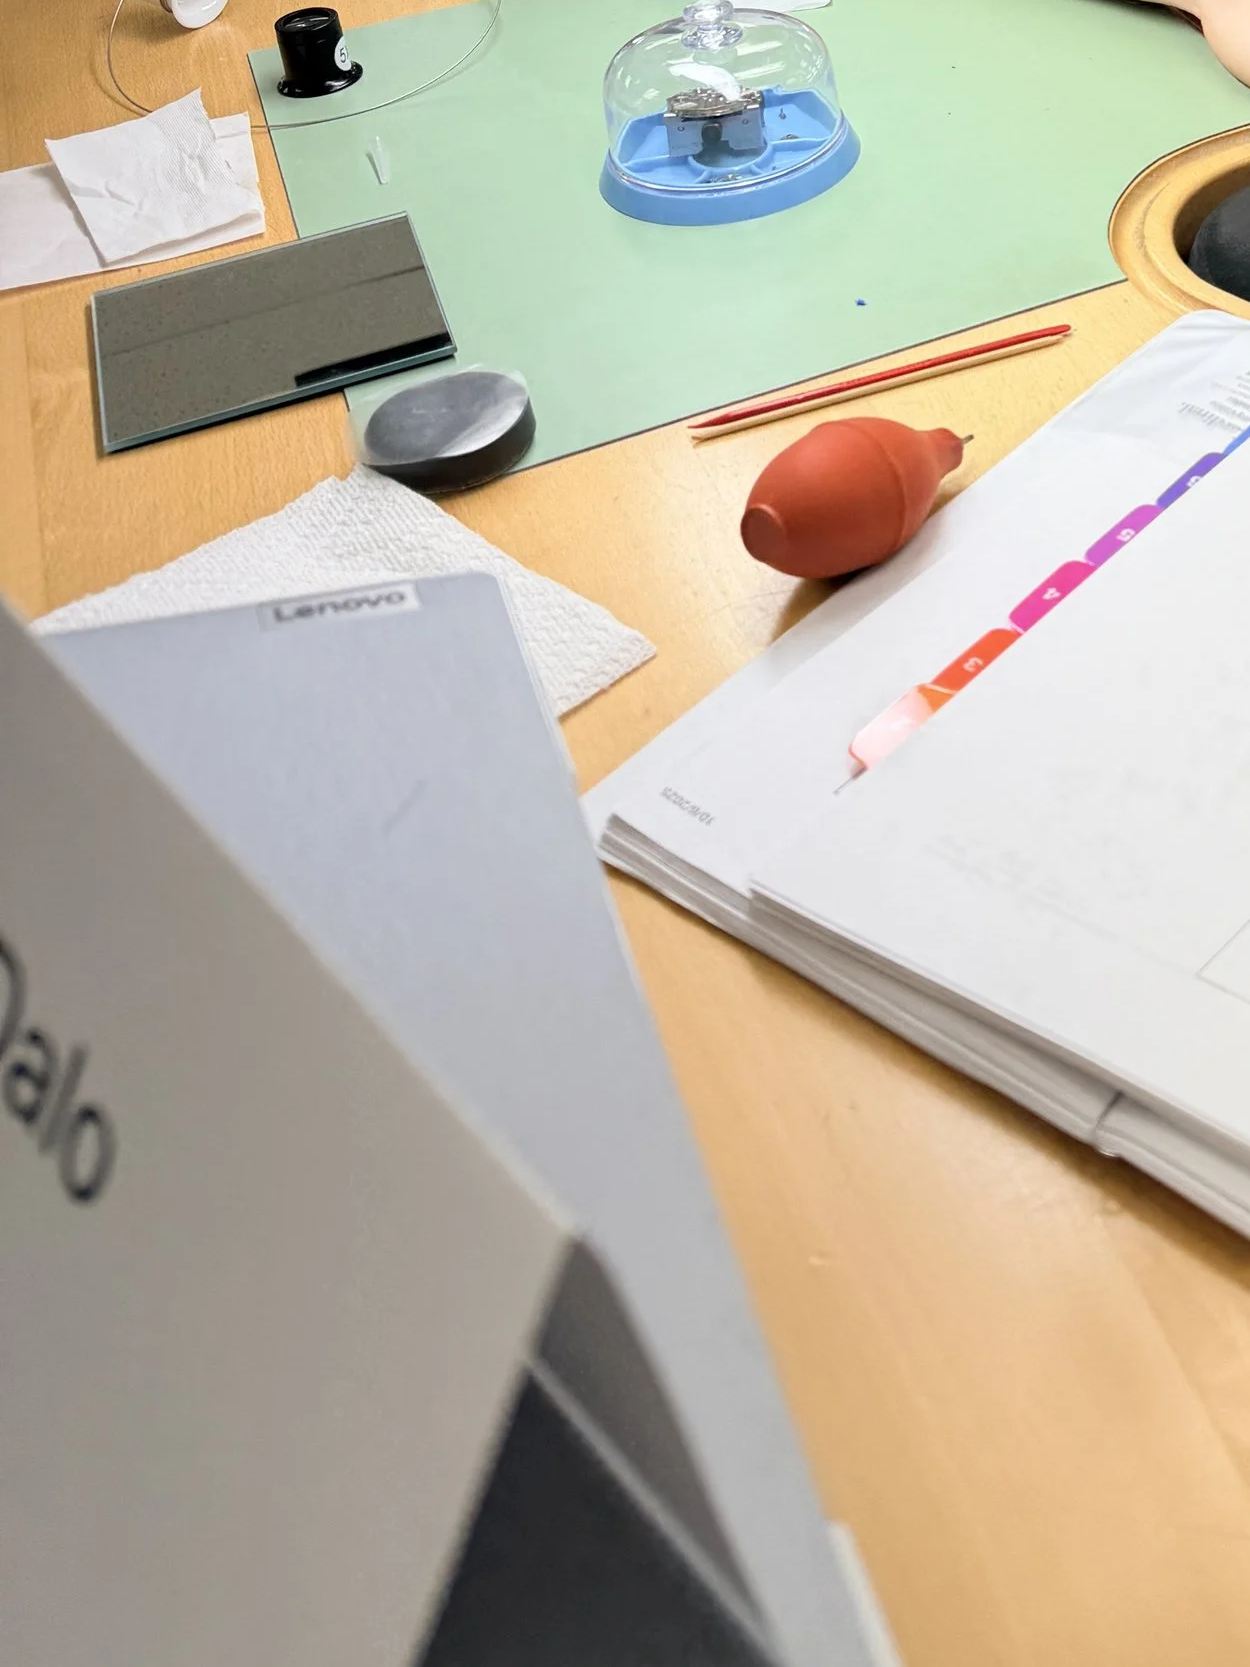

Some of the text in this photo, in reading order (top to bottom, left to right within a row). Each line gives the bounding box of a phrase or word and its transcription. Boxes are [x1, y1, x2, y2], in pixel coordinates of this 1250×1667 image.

[1115, 527, 1135, 541] 5
[1041, 586, 1060, 599] 4
[273, 590, 405, 625] Lenovo
[962, 656, 983, 671] 3
